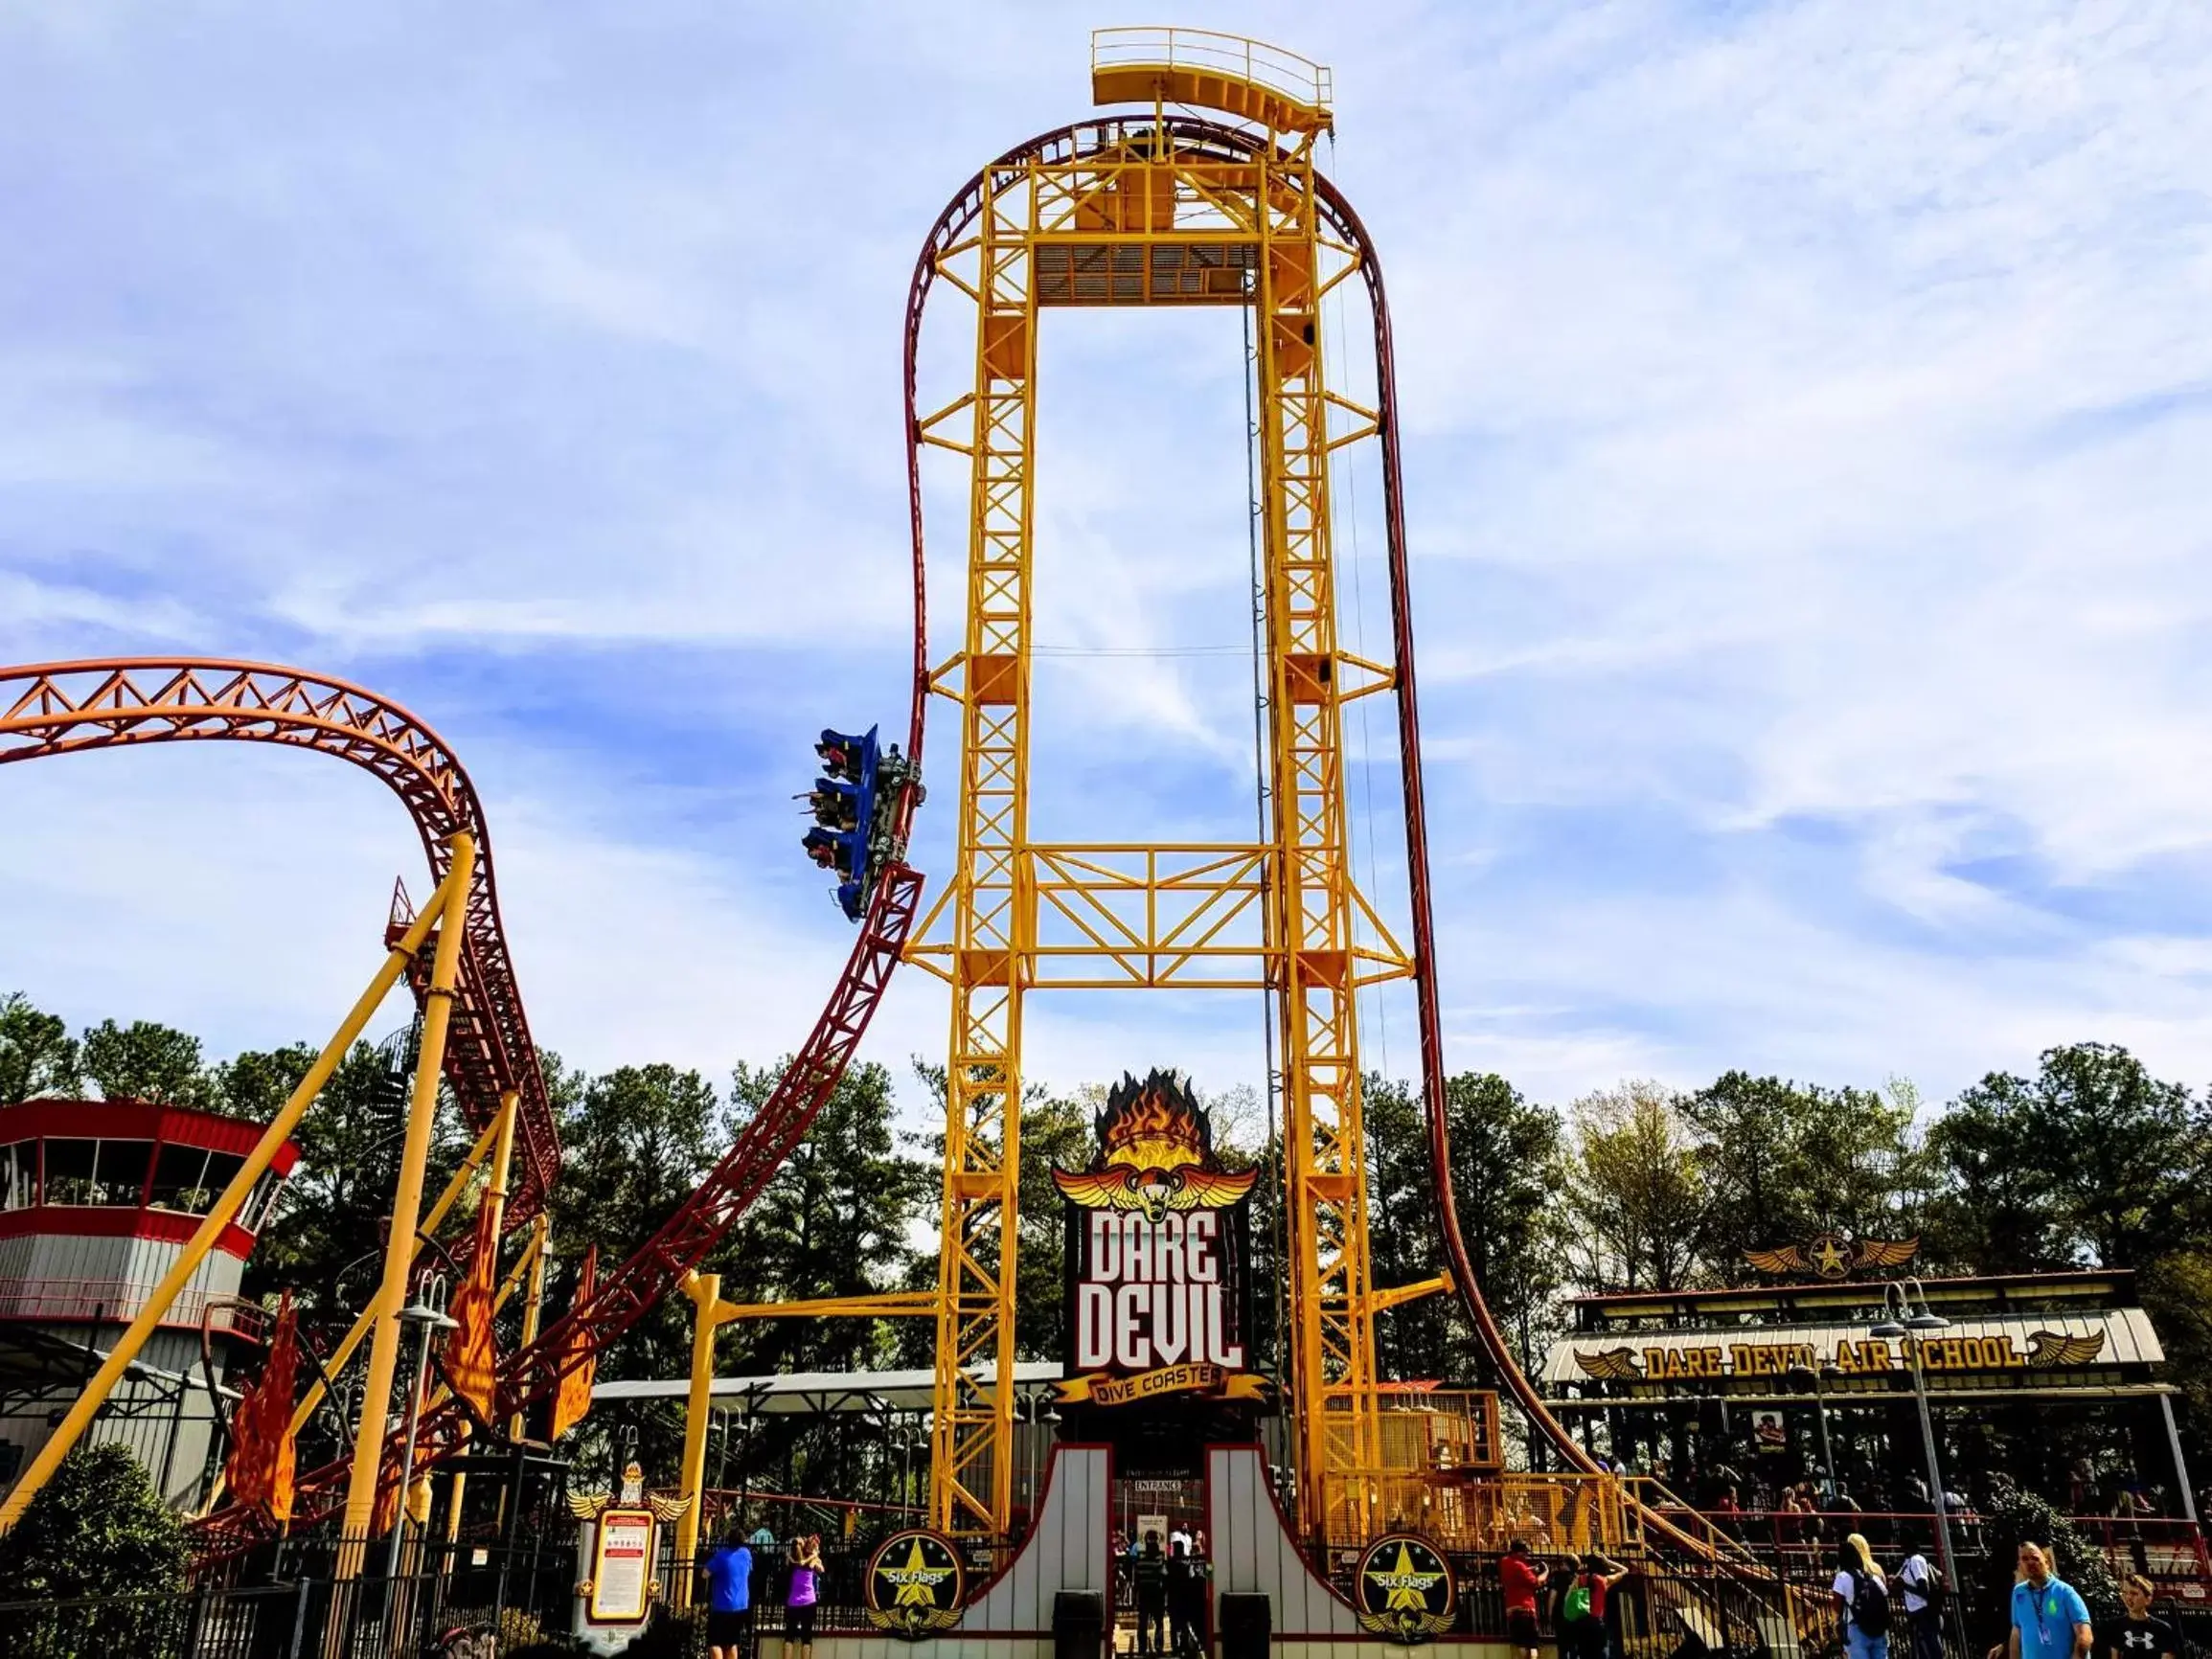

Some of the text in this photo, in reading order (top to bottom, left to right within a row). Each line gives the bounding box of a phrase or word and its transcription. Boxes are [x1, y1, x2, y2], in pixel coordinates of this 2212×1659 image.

[1090, 1210, 1218, 1284] DARE
[1078, 1284, 1243, 1369] DEVIL
[1643, 1345, 1723, 1380] DARE
[1837, 1338, 1892, 1374] AIR
[1900, 1335, 2025, 1372] SCHOOL
[1096, 1366, 1221, 1402] DIVE COASTER
[1136, 1480, 1180, 1490] ENTRANCE
[887, 1570, 944, 1586] Six Flags
[1378, 1574, 1434, 1590] Six Flags
